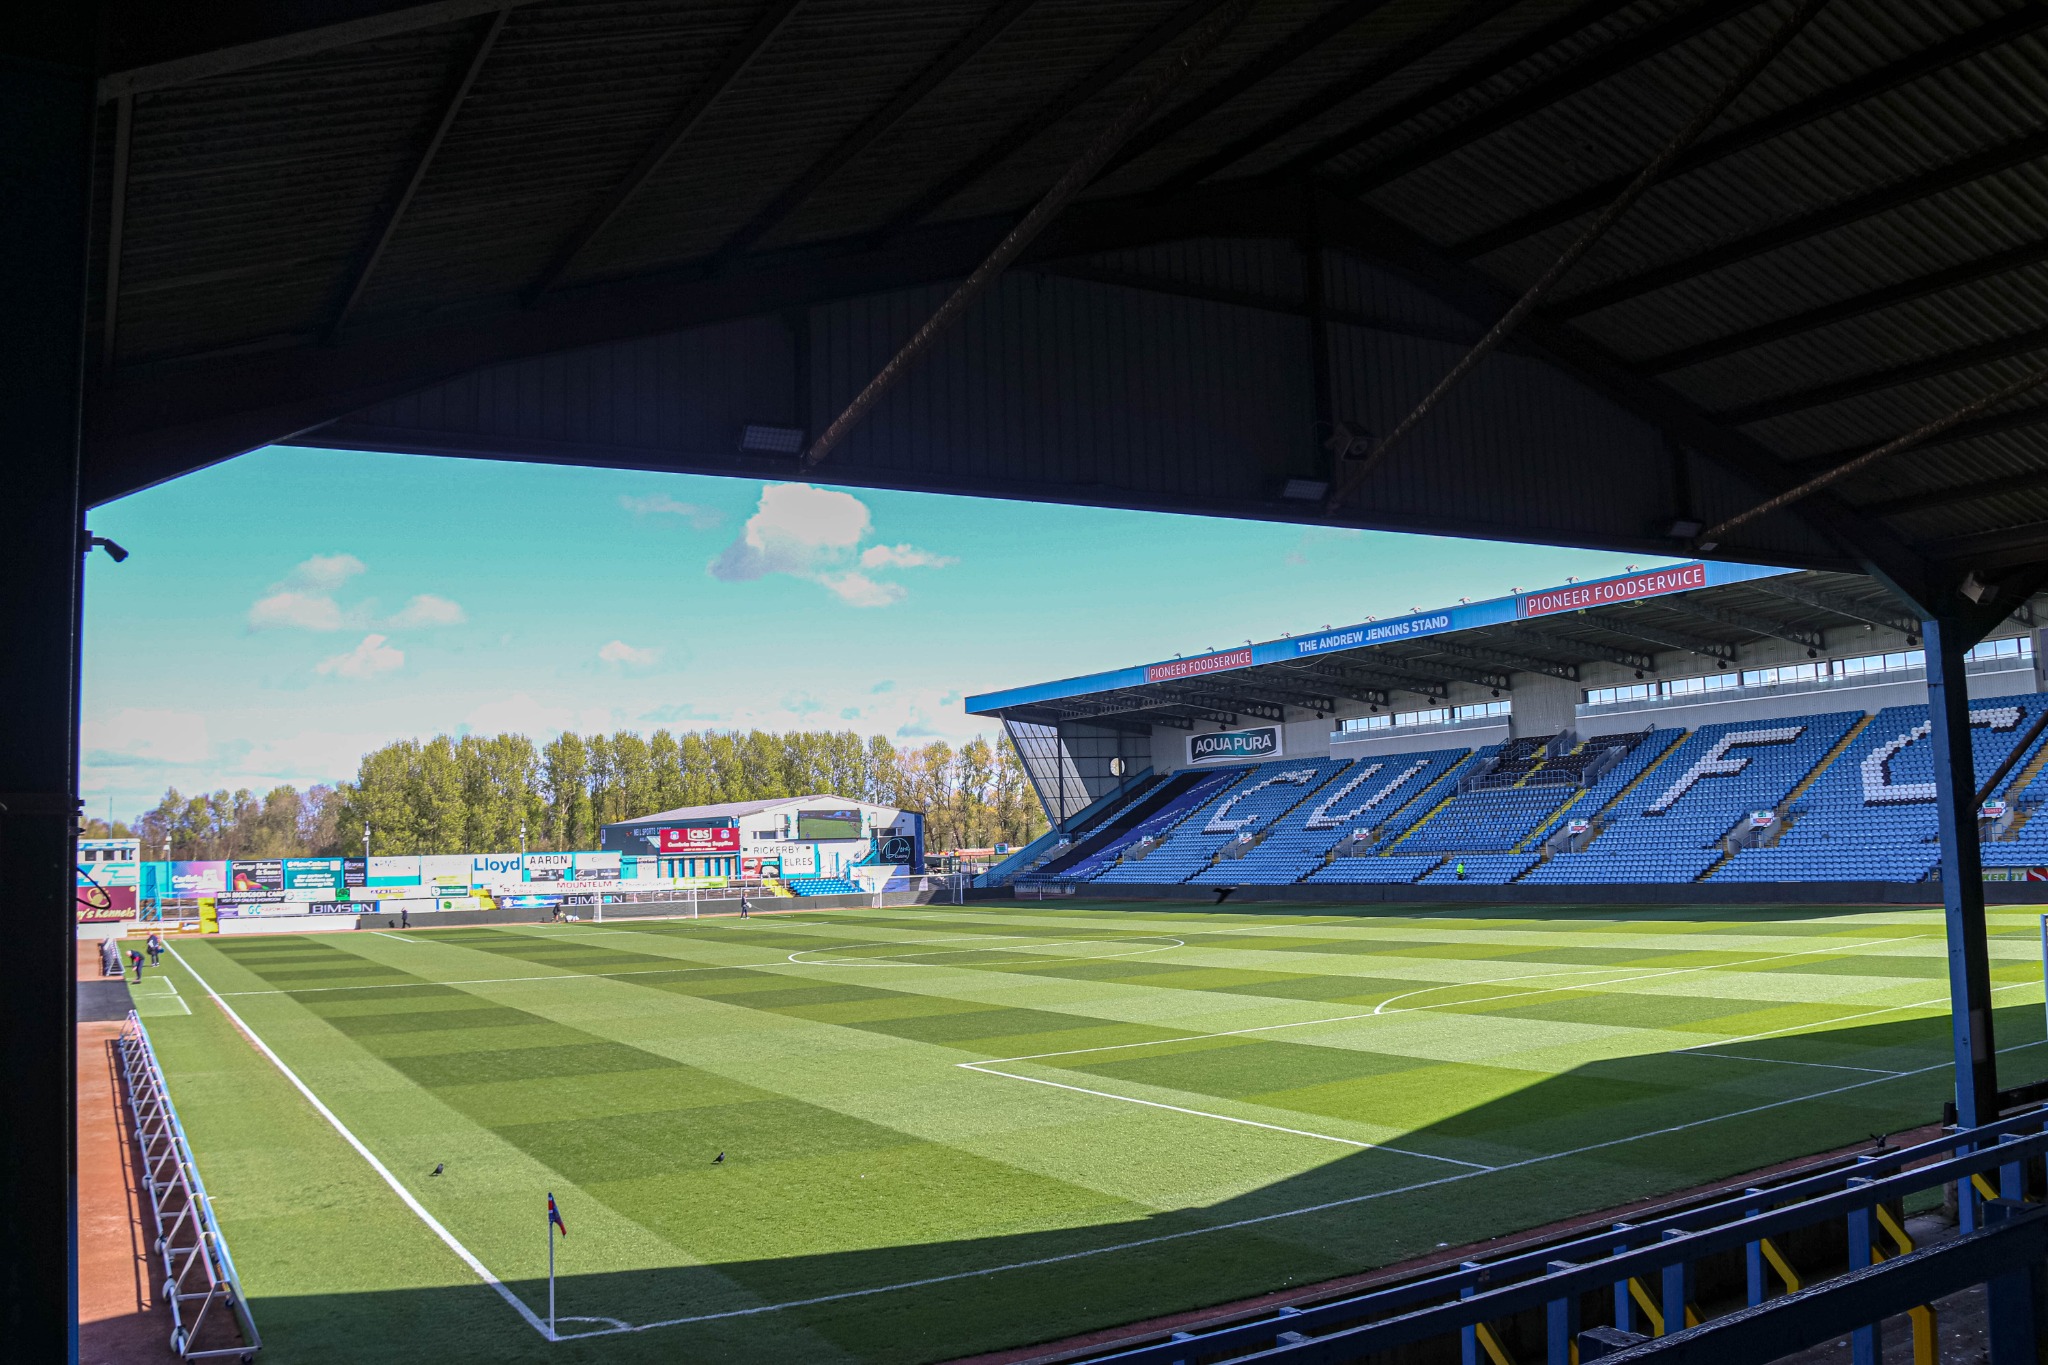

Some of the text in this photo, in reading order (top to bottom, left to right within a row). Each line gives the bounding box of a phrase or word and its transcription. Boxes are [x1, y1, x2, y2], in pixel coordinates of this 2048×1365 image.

[1528, 568, 1702, 613] PIONEER FOODSERVICE
[1298, 616, 1448, 653] THE ANDREW JENKINS STAND
[1150, 650, 1250, 680] PIONEER FOODSERVICE
[1195, 734, 1272, 754] AQUA PURA
[690, 830, 710, 838] CBS
[754, 846, 800, 854] RICKERBY
[474, 857, 520, 873] Lloyd
[530, 856, 568, 864] AARON
[556, 880, 612, 888] MOUNTELM
[95, 906, 136, 918] Kennels
